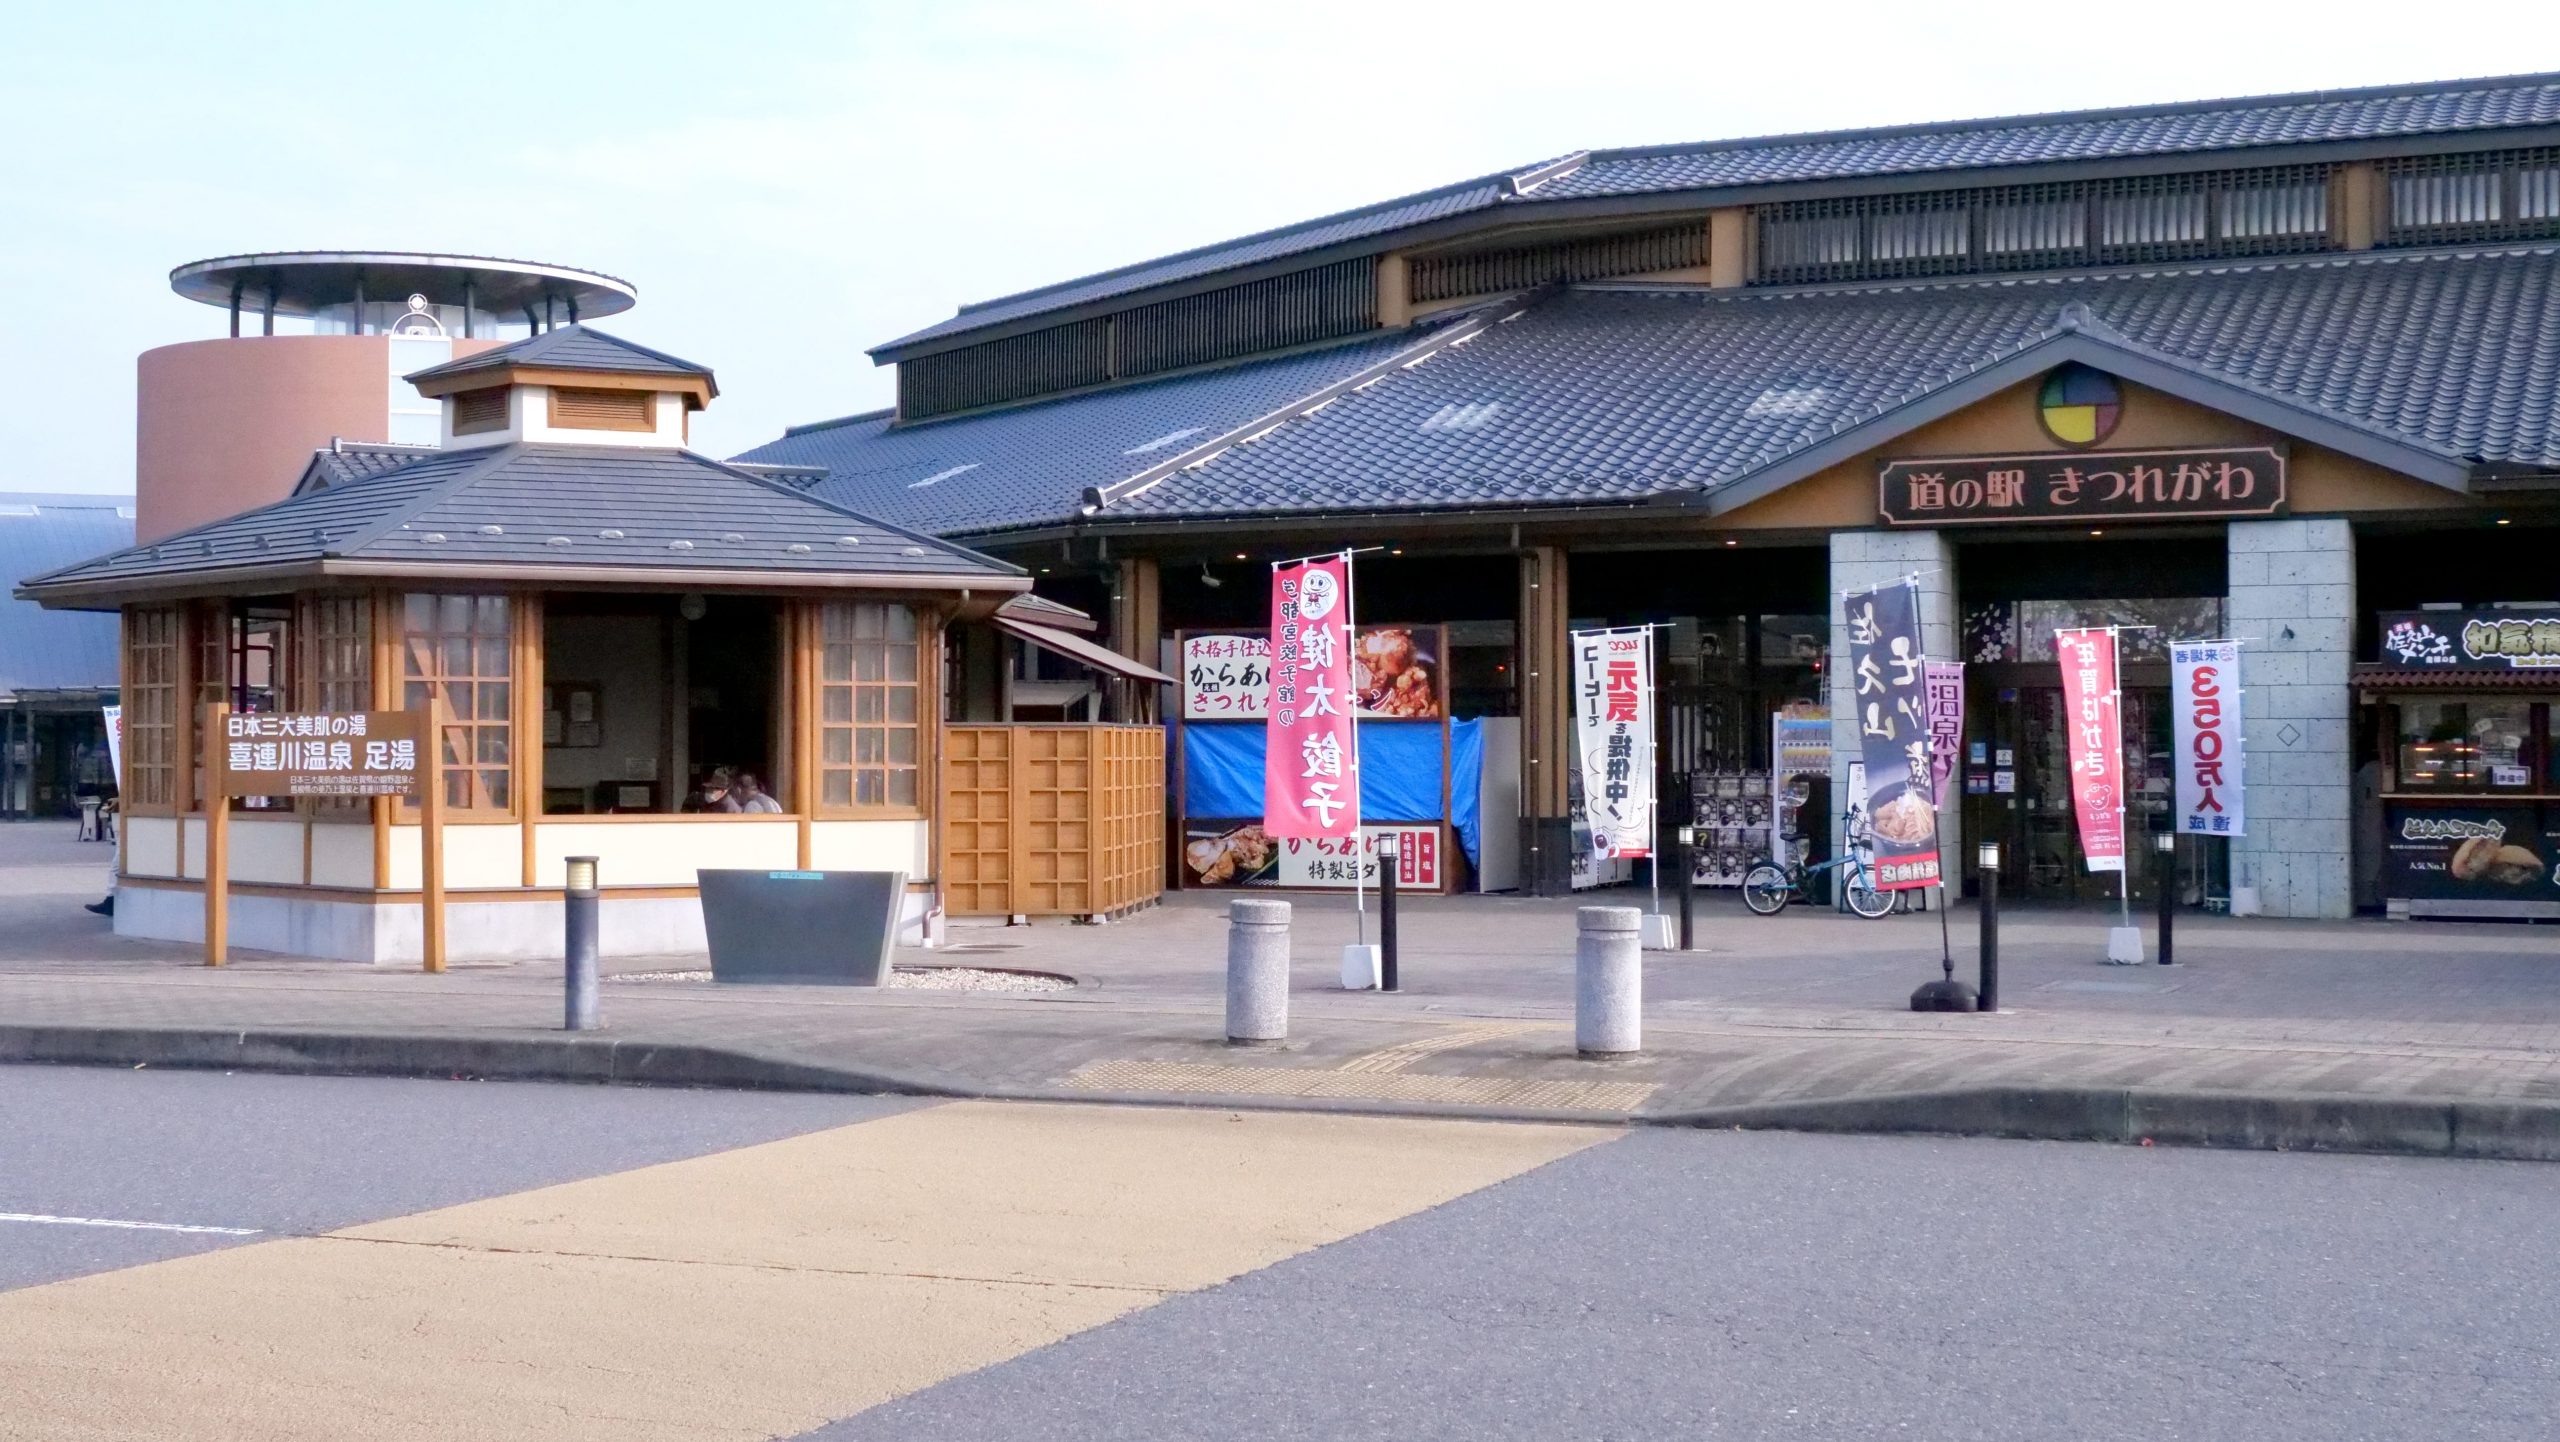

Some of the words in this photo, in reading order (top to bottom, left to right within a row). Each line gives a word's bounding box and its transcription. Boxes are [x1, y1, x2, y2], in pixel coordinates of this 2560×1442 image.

[1907, 471, 2025, 510] 道の駅
[2048, 461, 2255, 506] きつれがわ
[2399, 636, 2452, 664] メンチ
[228, 714, 367, 737] 日本三大美肌の湯
[228, 740, 353, 771] 喜連川温泉
[364, 739, 416, 771] 足湯
[1422, 844, 1432, 870] 旨塩
